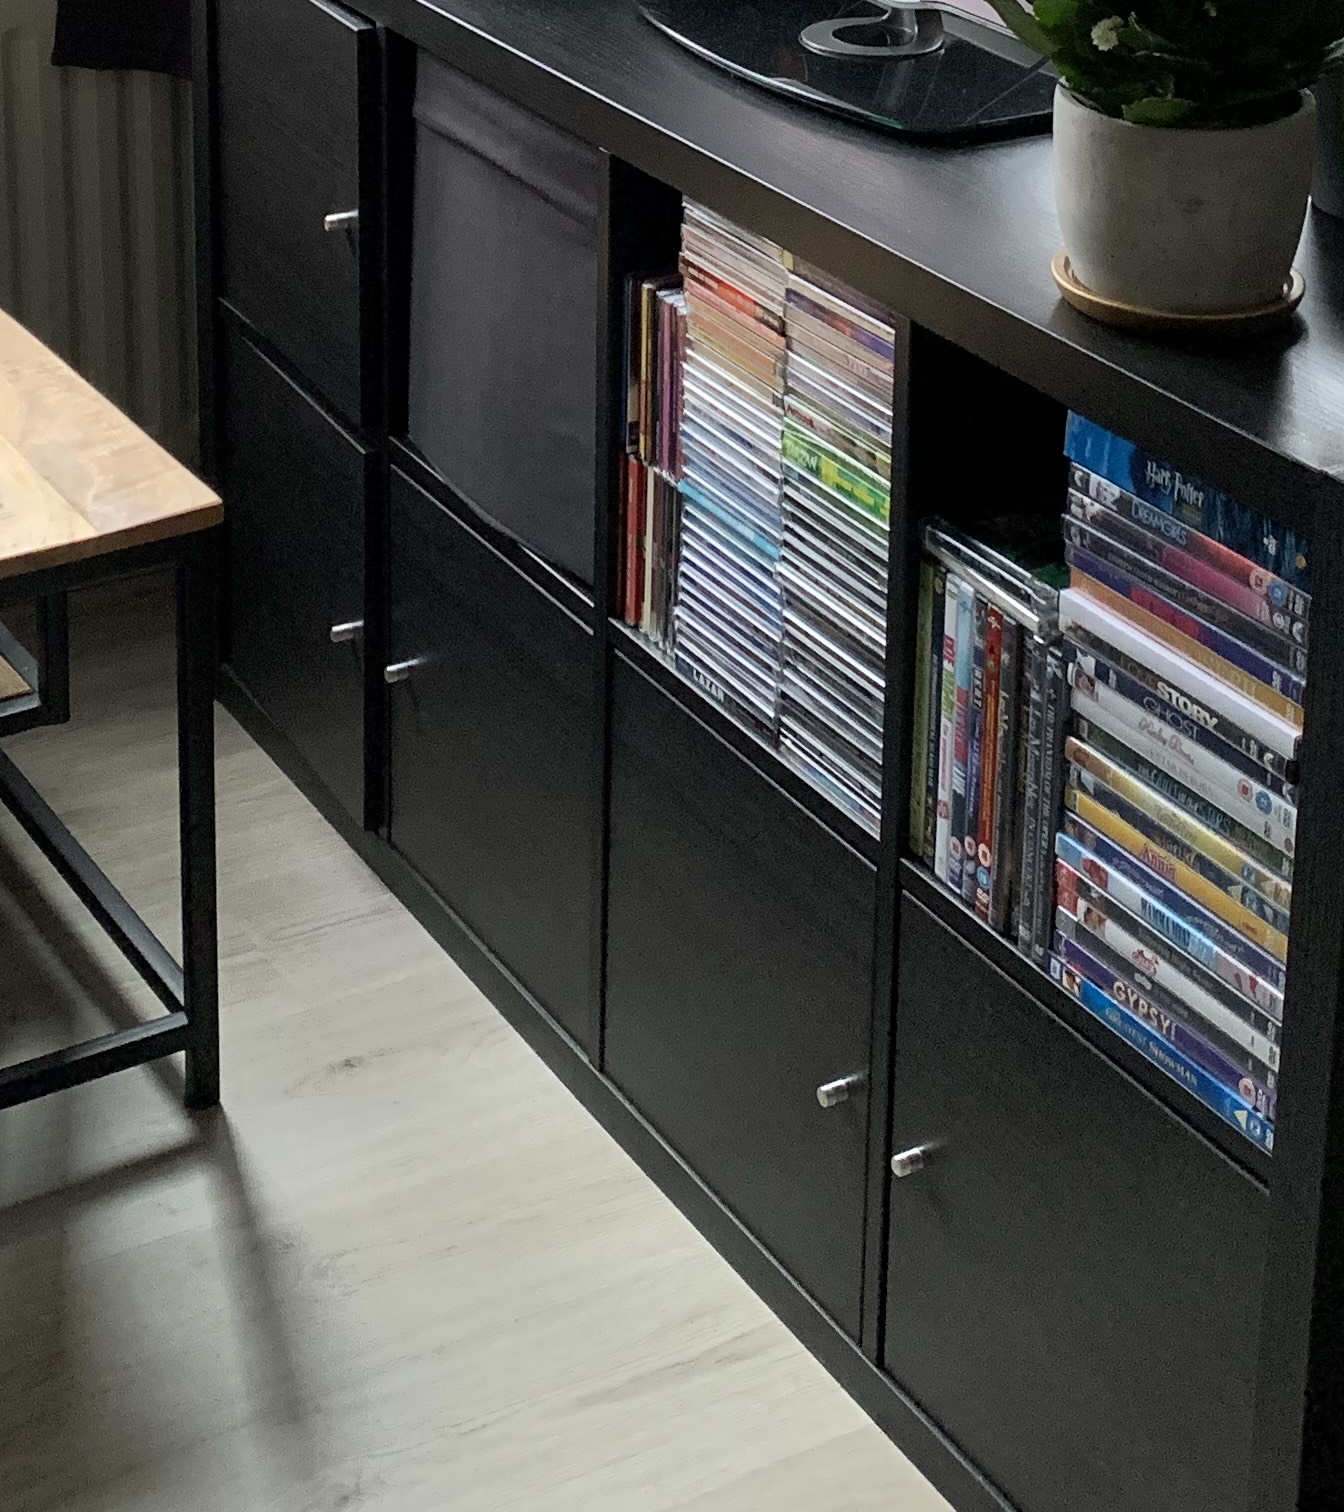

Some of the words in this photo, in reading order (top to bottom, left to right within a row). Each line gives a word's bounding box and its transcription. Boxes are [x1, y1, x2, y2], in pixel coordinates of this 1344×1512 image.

[1145, 461, 1173, 495] Harry
[1173, 470, 1205, 508] Potter
[972, 666, 983, 709] RENT
[1156, 681, 1219, 730] STORY
[1142, 695, 1201, 740] GHOST
[1042, 724, 1054, 782] PHANTOM
[1139, 843, 1176, 882] Annie
[1113, 980, 1176, 1040] GYPSY!
